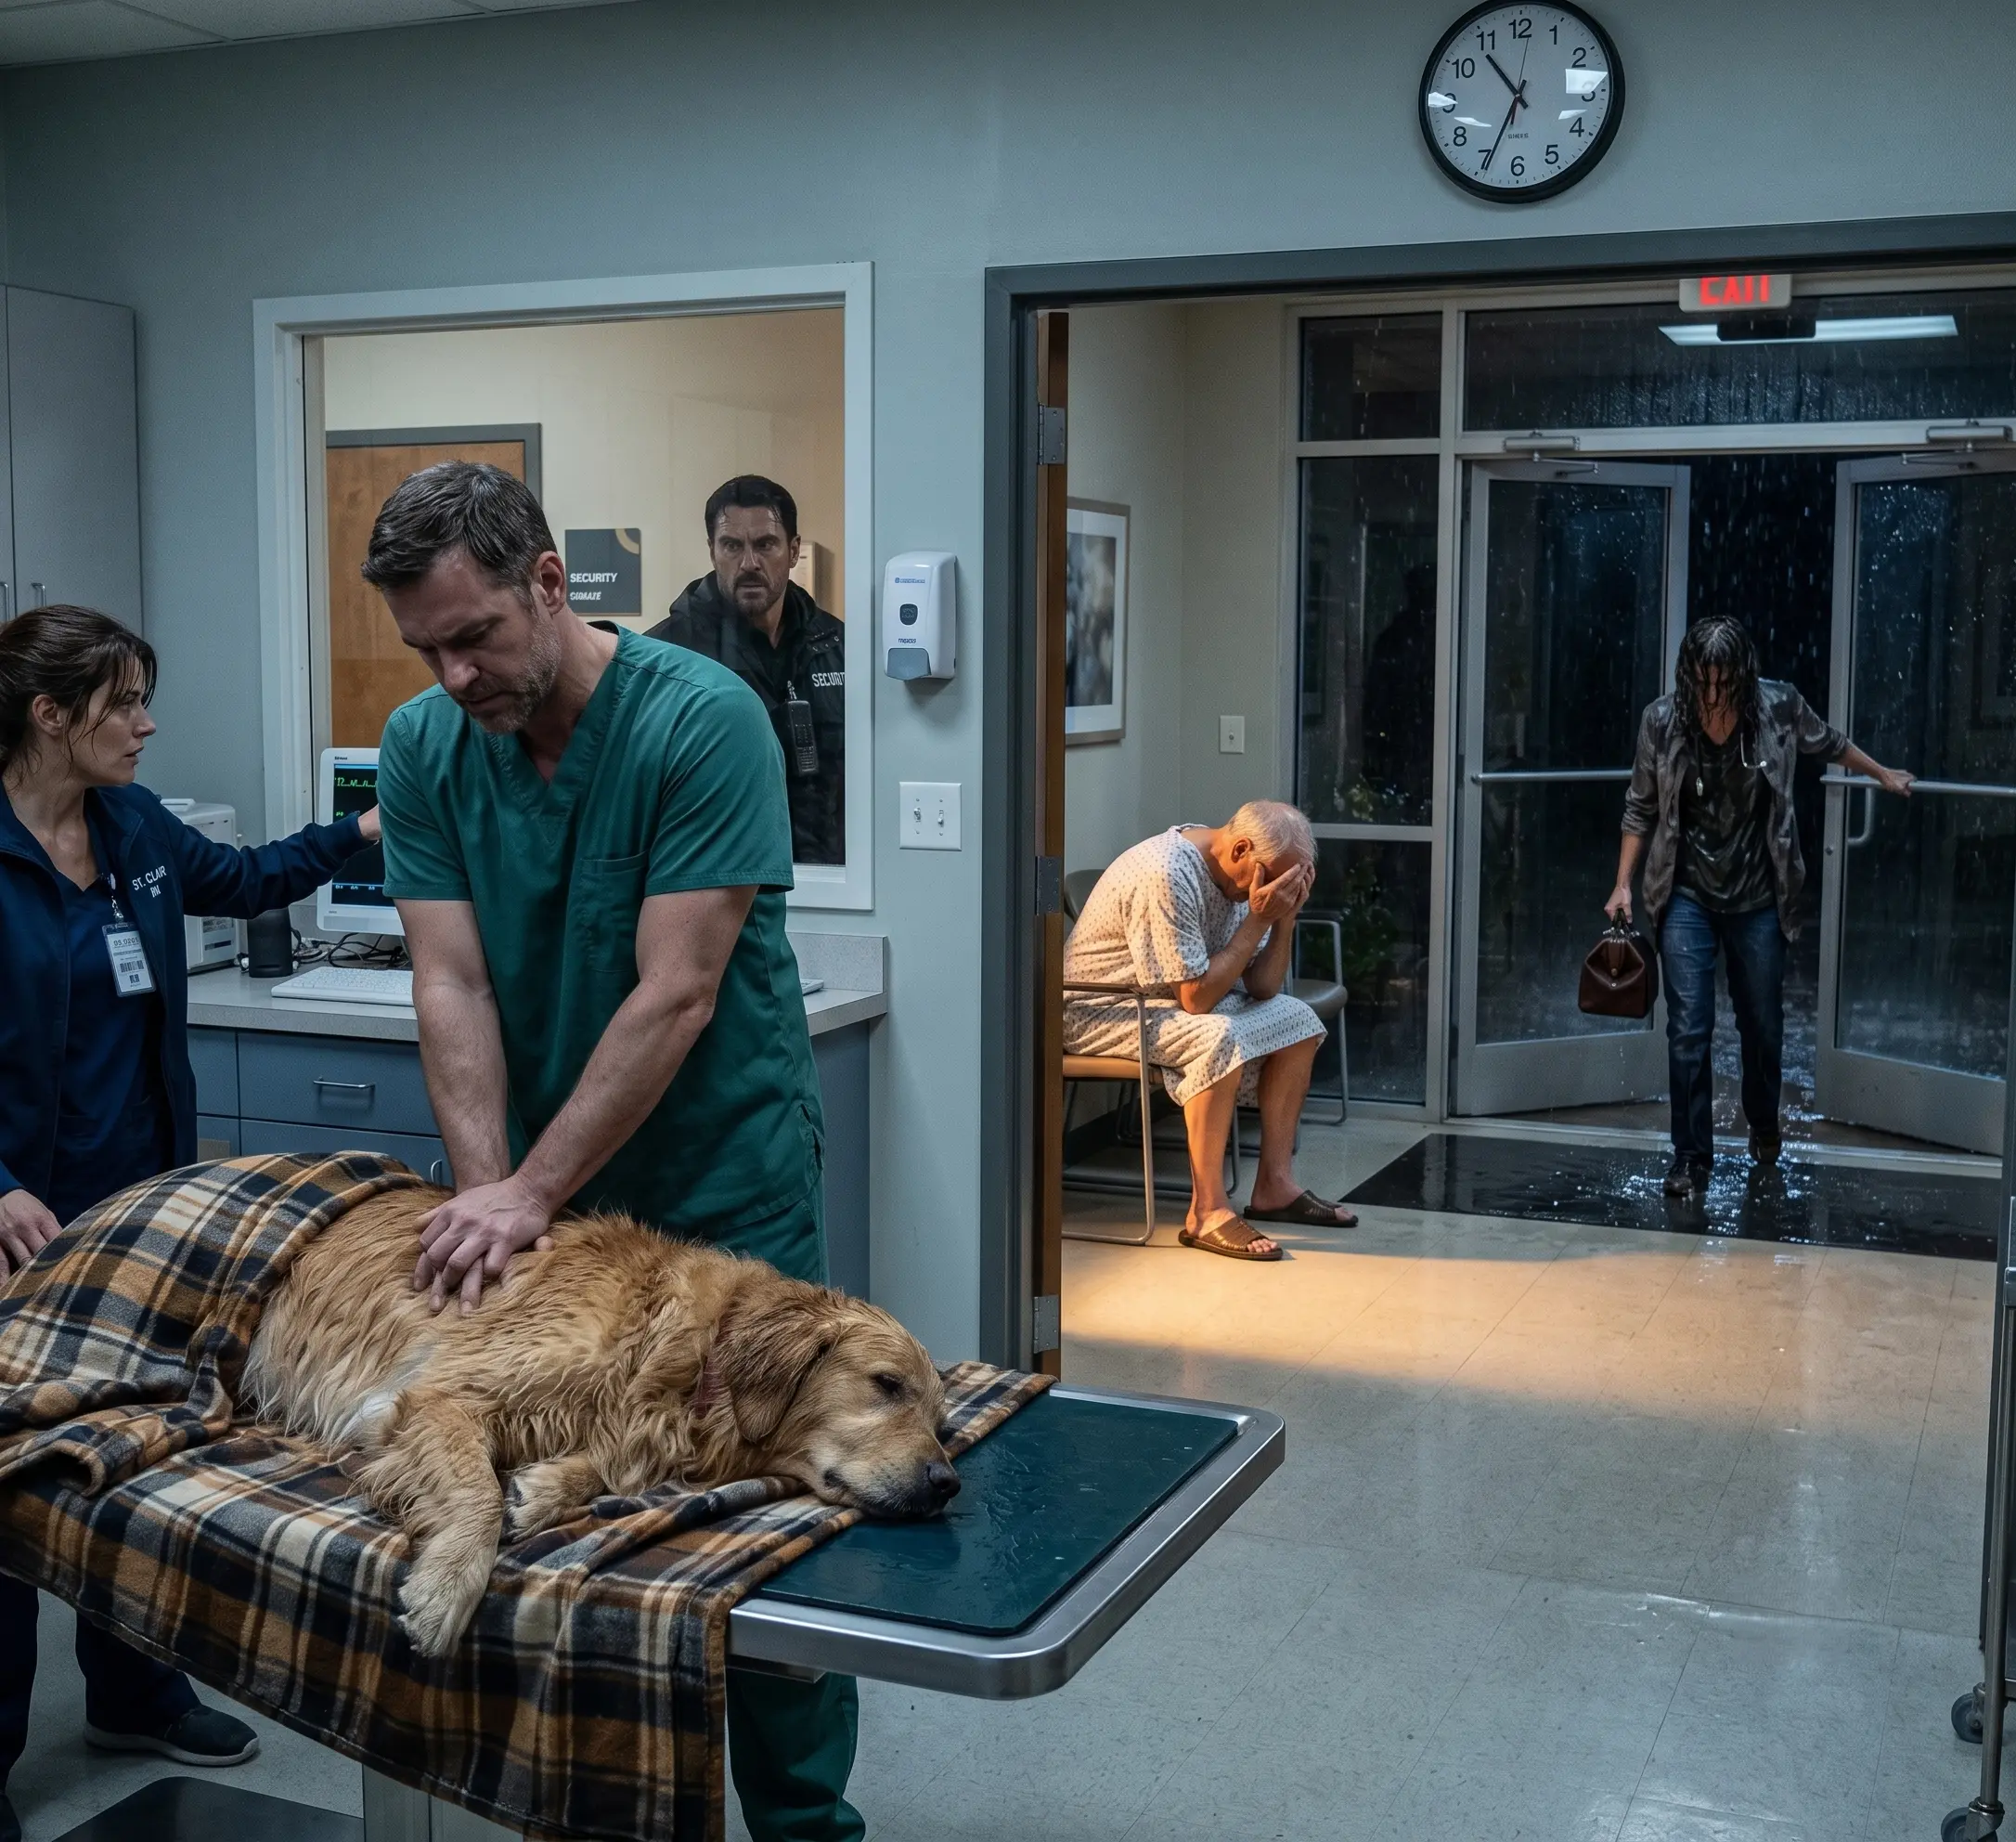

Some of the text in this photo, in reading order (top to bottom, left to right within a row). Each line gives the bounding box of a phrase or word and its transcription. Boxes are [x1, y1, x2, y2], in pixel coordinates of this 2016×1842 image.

[1508, 18, 1532, 40] 12
[1549, 25, 1557, 45] 1
[1476, 30, 1495, 51] 11
[1452, 58, 1475, 79] 10
[1571, 47, 1586, 69] 2
[1442, 92, 1456, 114] 9
[1453, 126, 1467, 147] 8
[1569, 117, 1585, 137] 4
[1478, 149, 1492, 170] 7
[1544, 144, 1558, 164] 5
[1510, 156, 1525, 176] 6
[569, 572, 618, 583] SECURITY
[811, 671, 846, 687] SECURIT
[132, 865, 167, 891] ST. CLAIR
